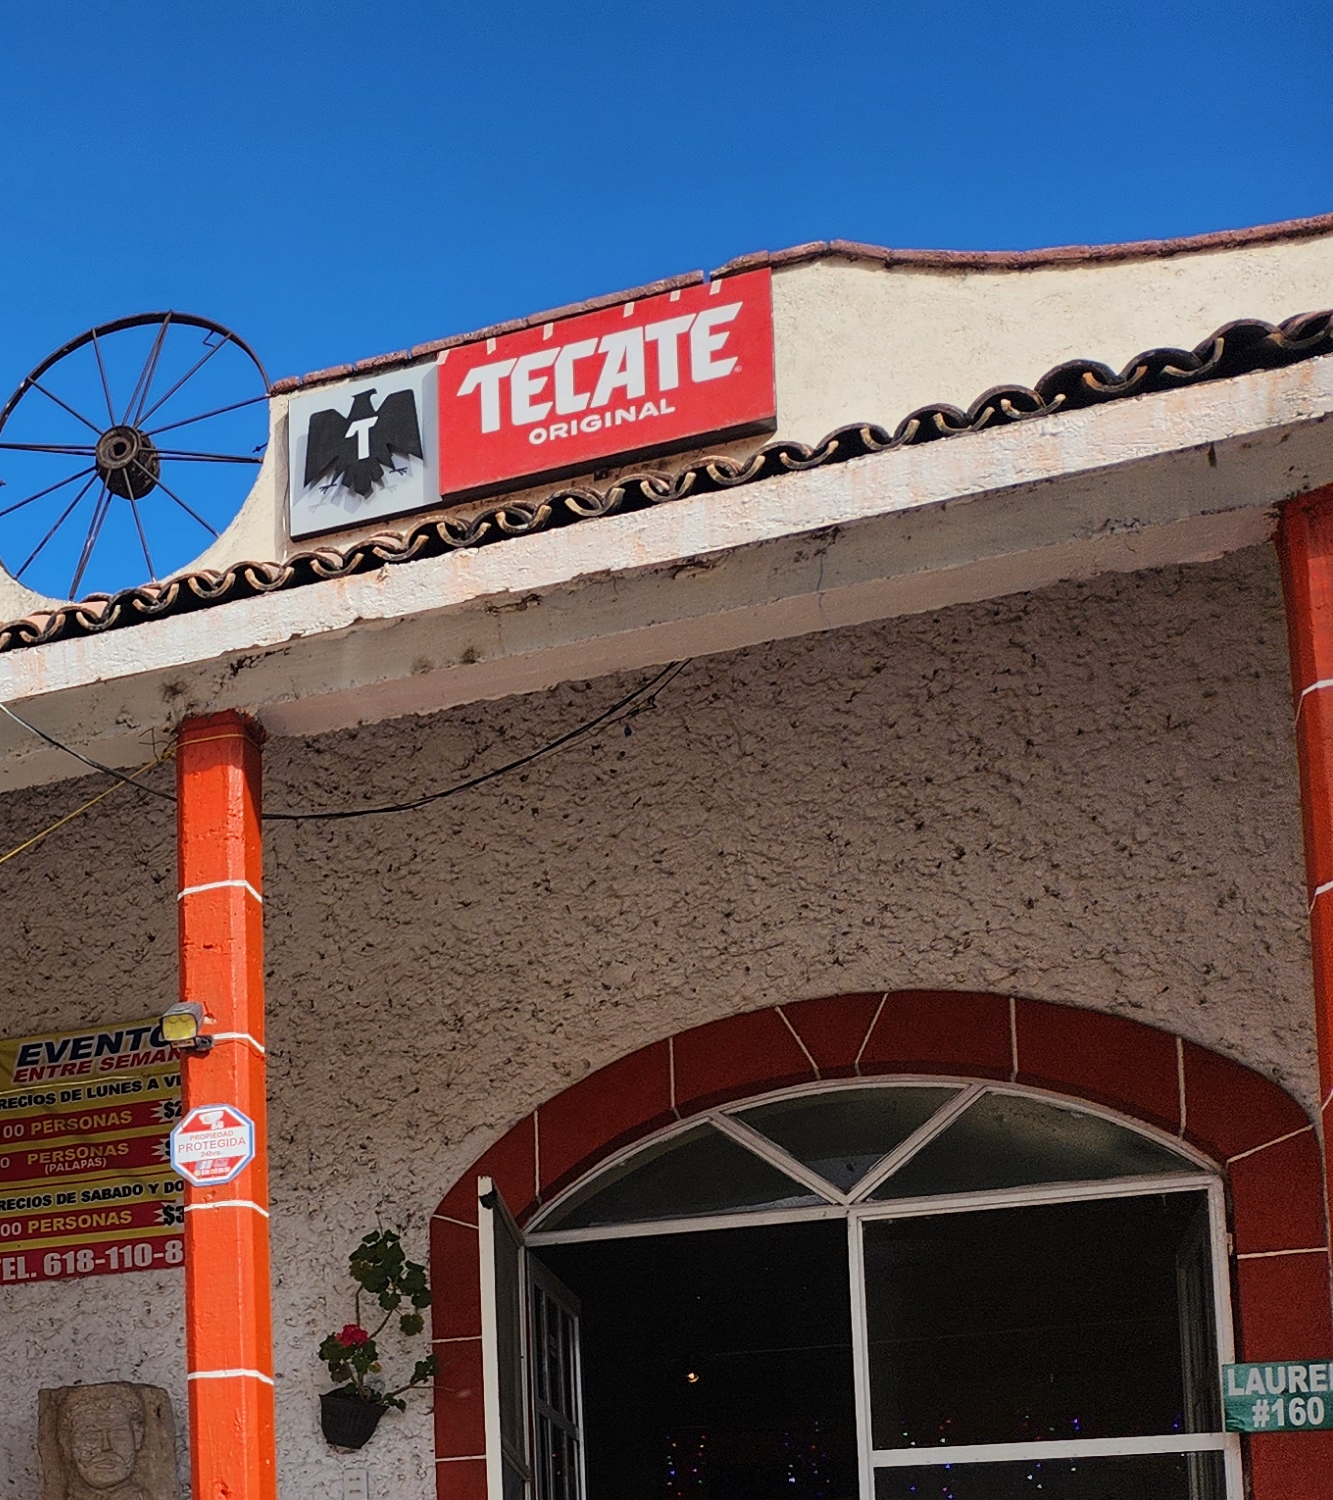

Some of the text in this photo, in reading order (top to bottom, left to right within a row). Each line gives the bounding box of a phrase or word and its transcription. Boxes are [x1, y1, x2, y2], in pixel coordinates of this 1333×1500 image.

[457, 301, 743, 434] TECATE
[528, 398, 676, 446] ORIGINAL
[13, 1060, 92, 1083] ENTRE
[60, 1089, 82, 1104] DE
[87, 1080, 142, 1099] LUNES
[147, 1078, 159, 1090] A
[30, 1110, 133, 1135] PERSONAS
[178, 1137, 246, 1153] PROTEGIDA
[189, 1130, 234, 1141] PROPIEDAD
[27, 1142, 130, 1165] PERSONAS
[45, 1157, 107, 1175] (PALAPAS)
[56, 1192, 77, 1205] DE
[81, 1183, 144, 1203] SABADO
[148, 1183, 160, 1194] Y
[27, 1210, 133, 1234] PERSONAS
[43, 1240, 184, 1276] 618-110-8
[1252, 1396, 1325, 1428] #160
